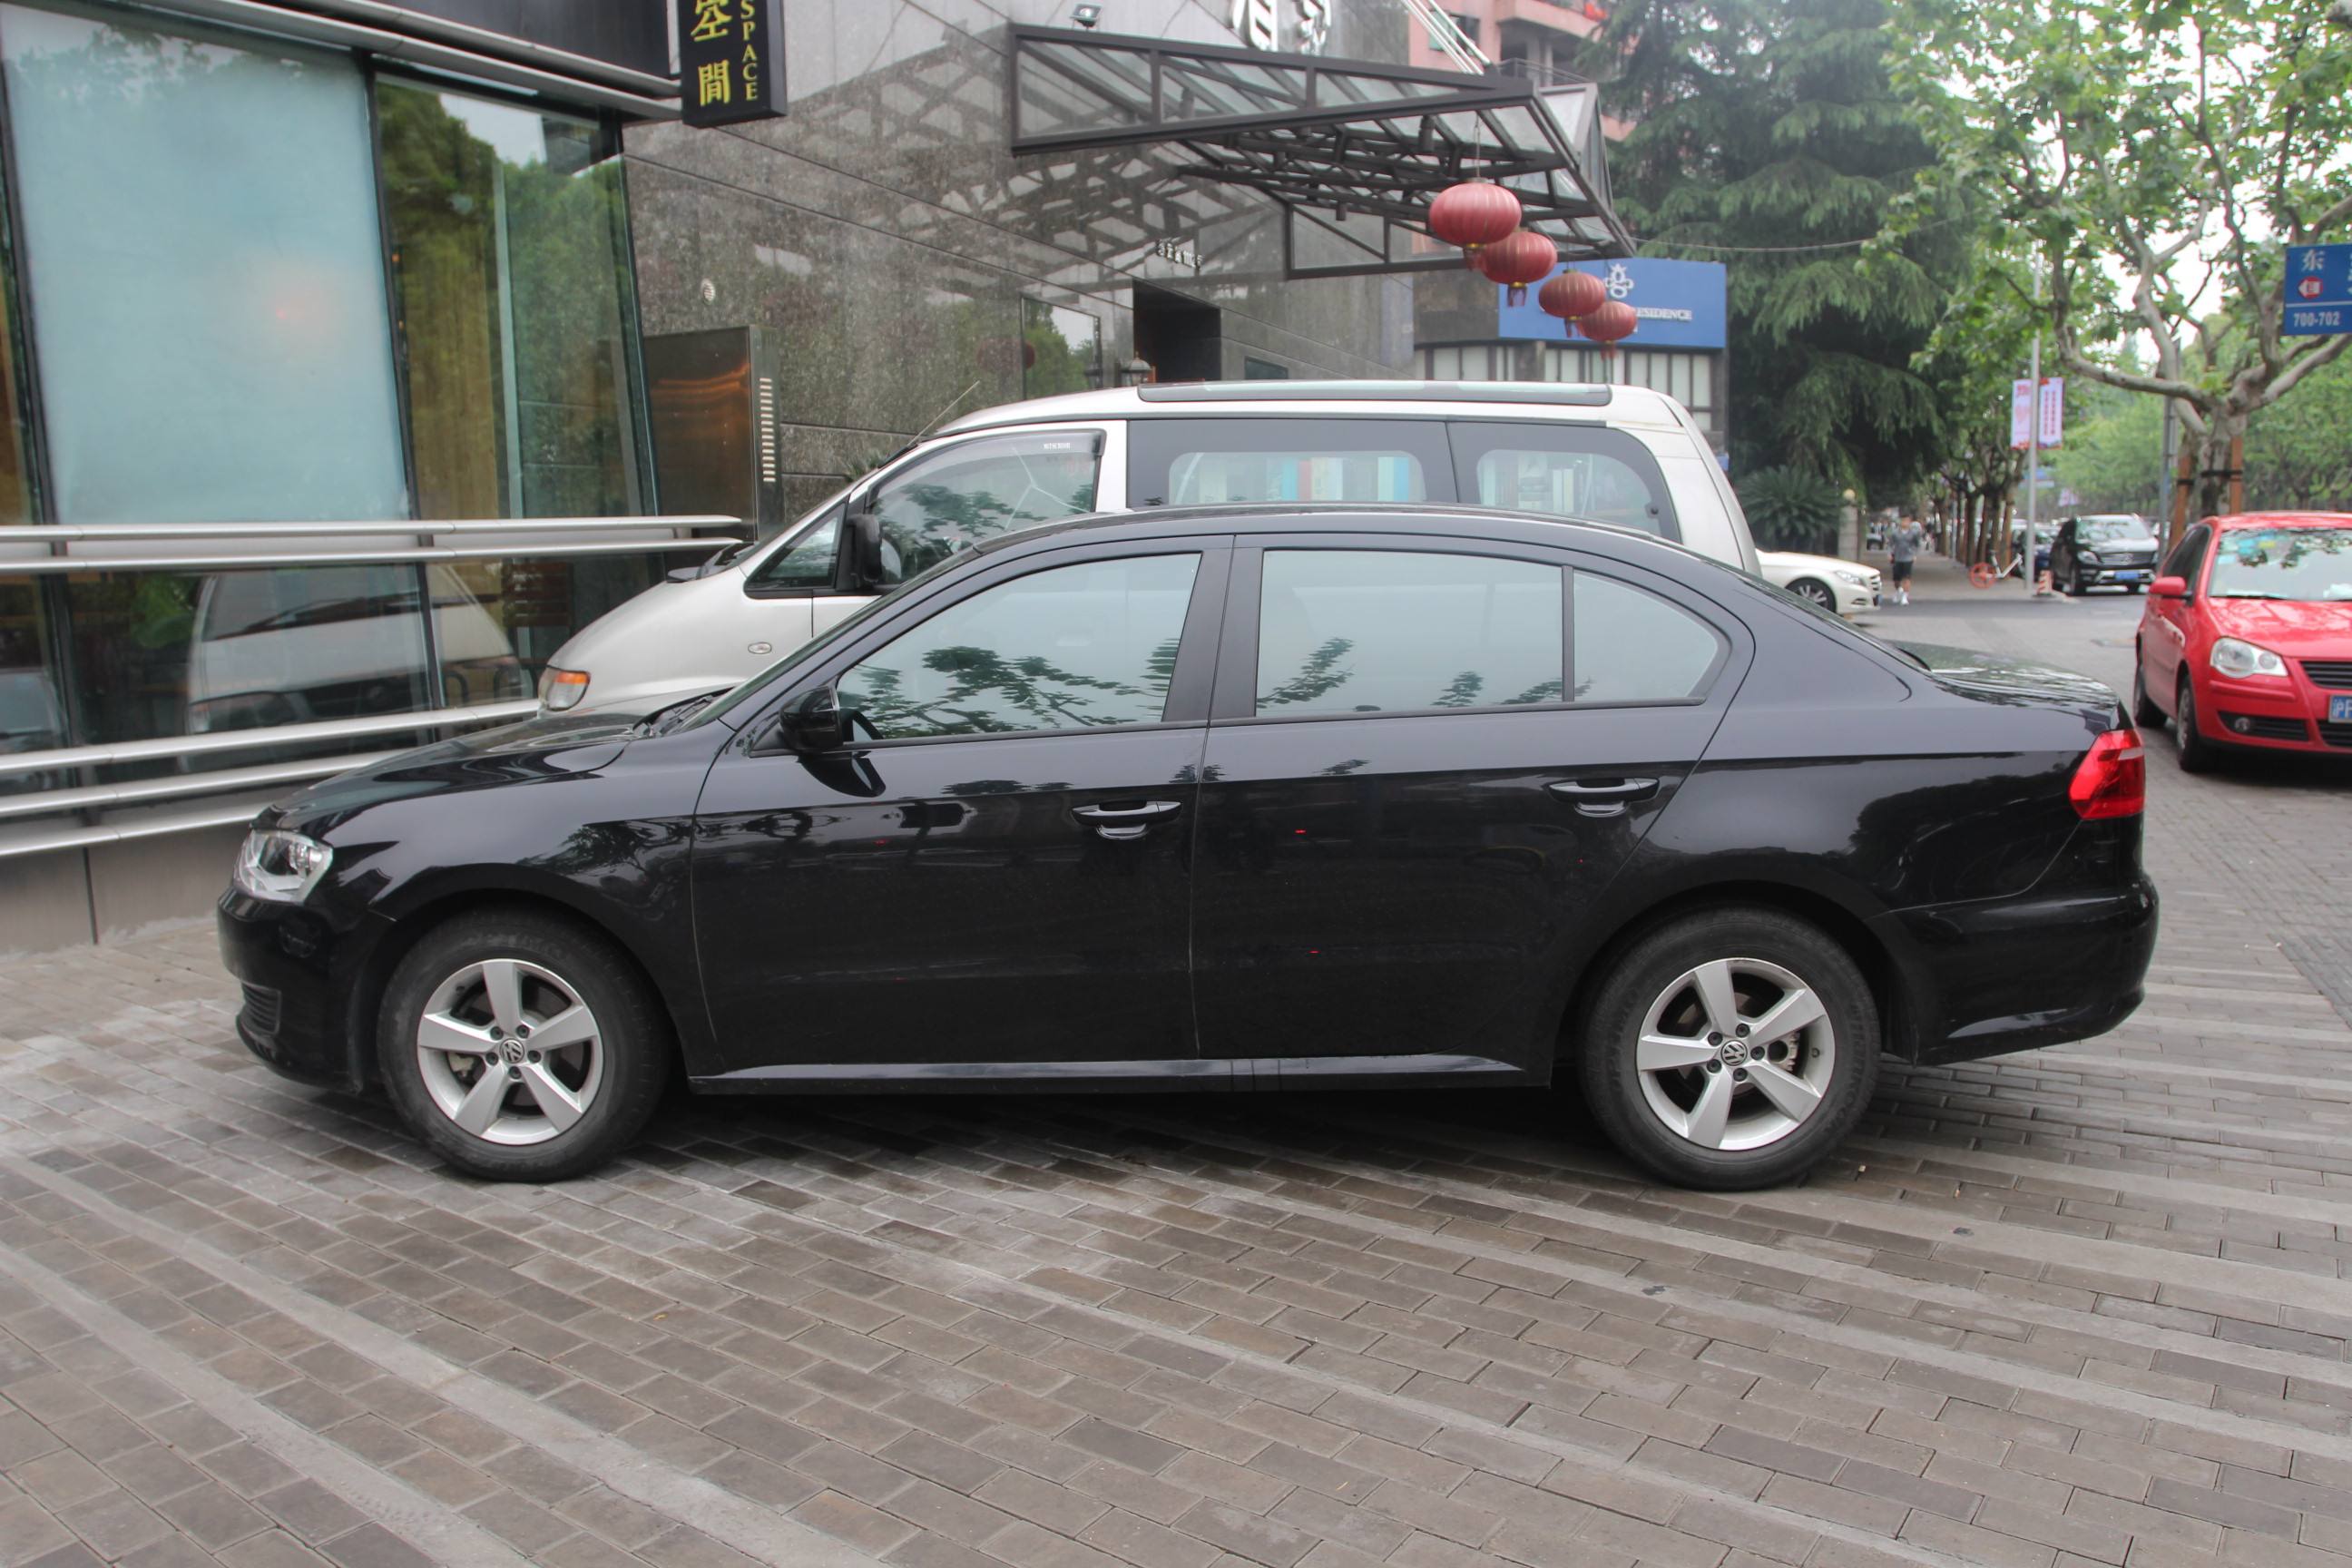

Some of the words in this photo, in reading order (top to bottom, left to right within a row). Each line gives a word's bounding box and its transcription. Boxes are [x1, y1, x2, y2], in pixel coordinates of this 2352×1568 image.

[740, 0, 759, 102] SPACE
[2300, 248, 2326, 272] 东
[1635, 307, 1692, 319] ESIDENCE
[2293, 310, 2341, 328] 700-702
